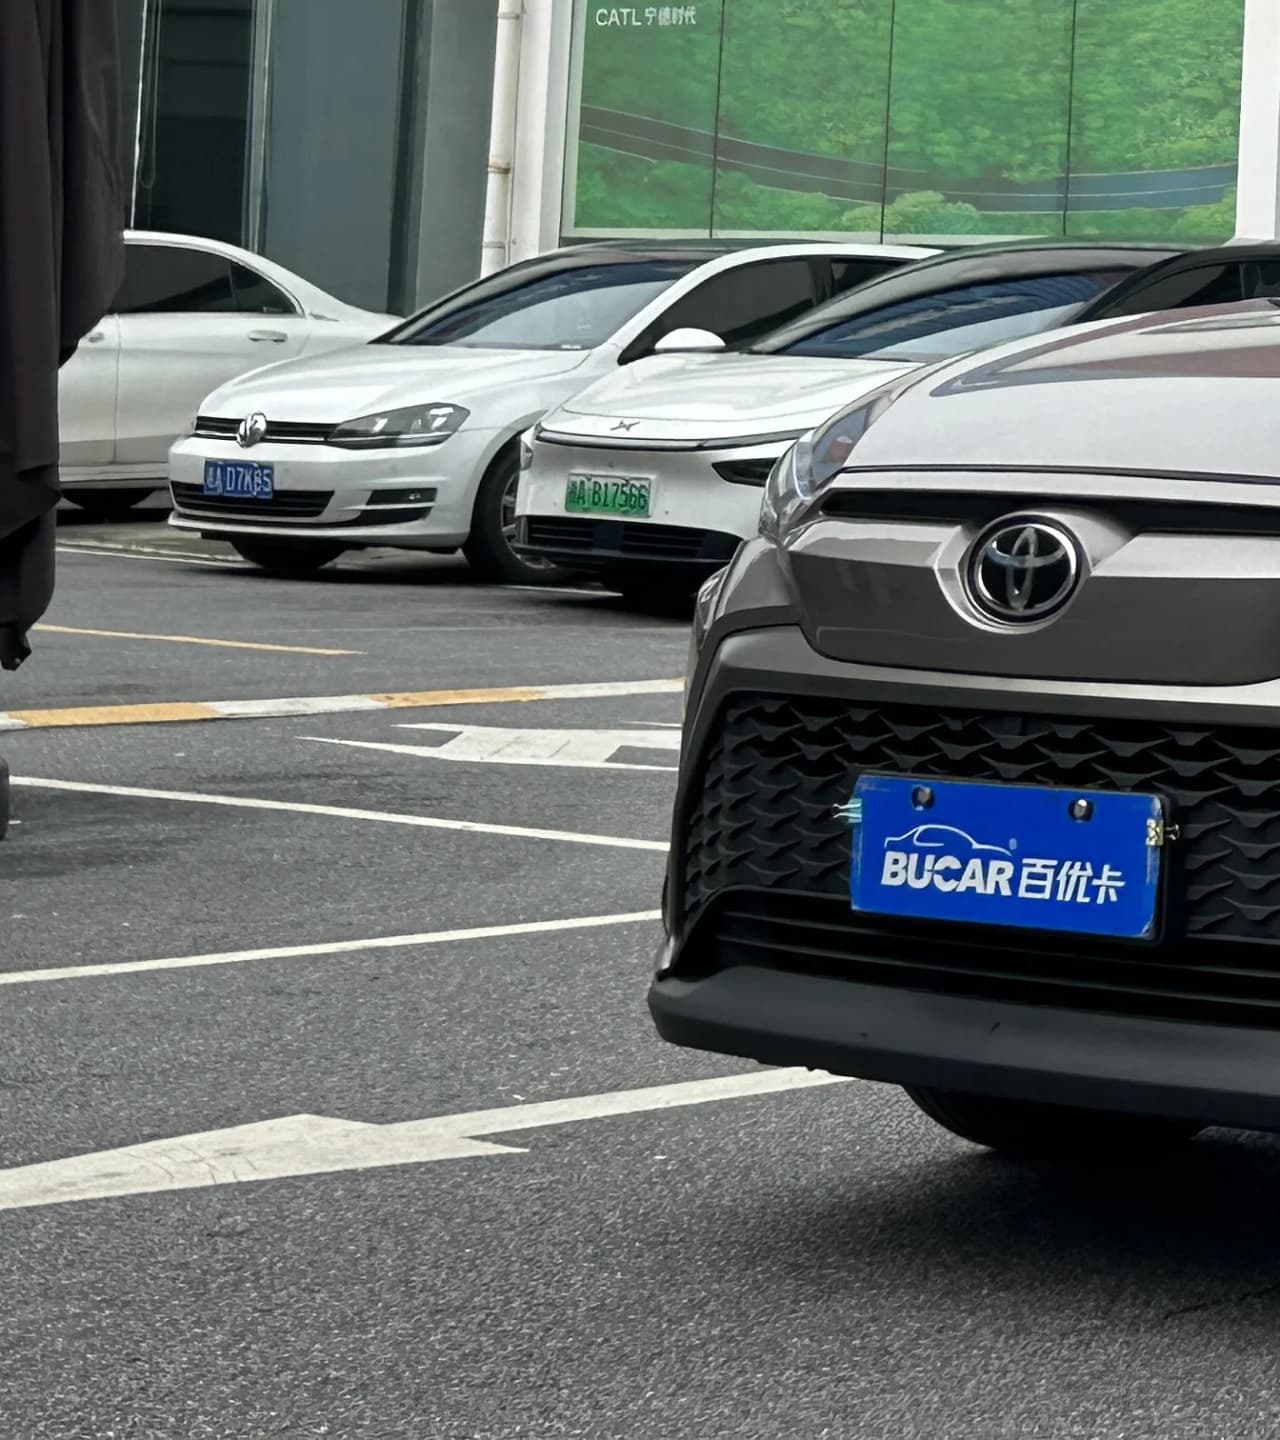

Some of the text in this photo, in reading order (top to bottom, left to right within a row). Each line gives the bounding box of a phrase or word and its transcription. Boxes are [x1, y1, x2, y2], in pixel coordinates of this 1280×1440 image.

[596, 7, 642, 26] CATL
[881, 850, 1126, 904] BUCAR 百优卡
